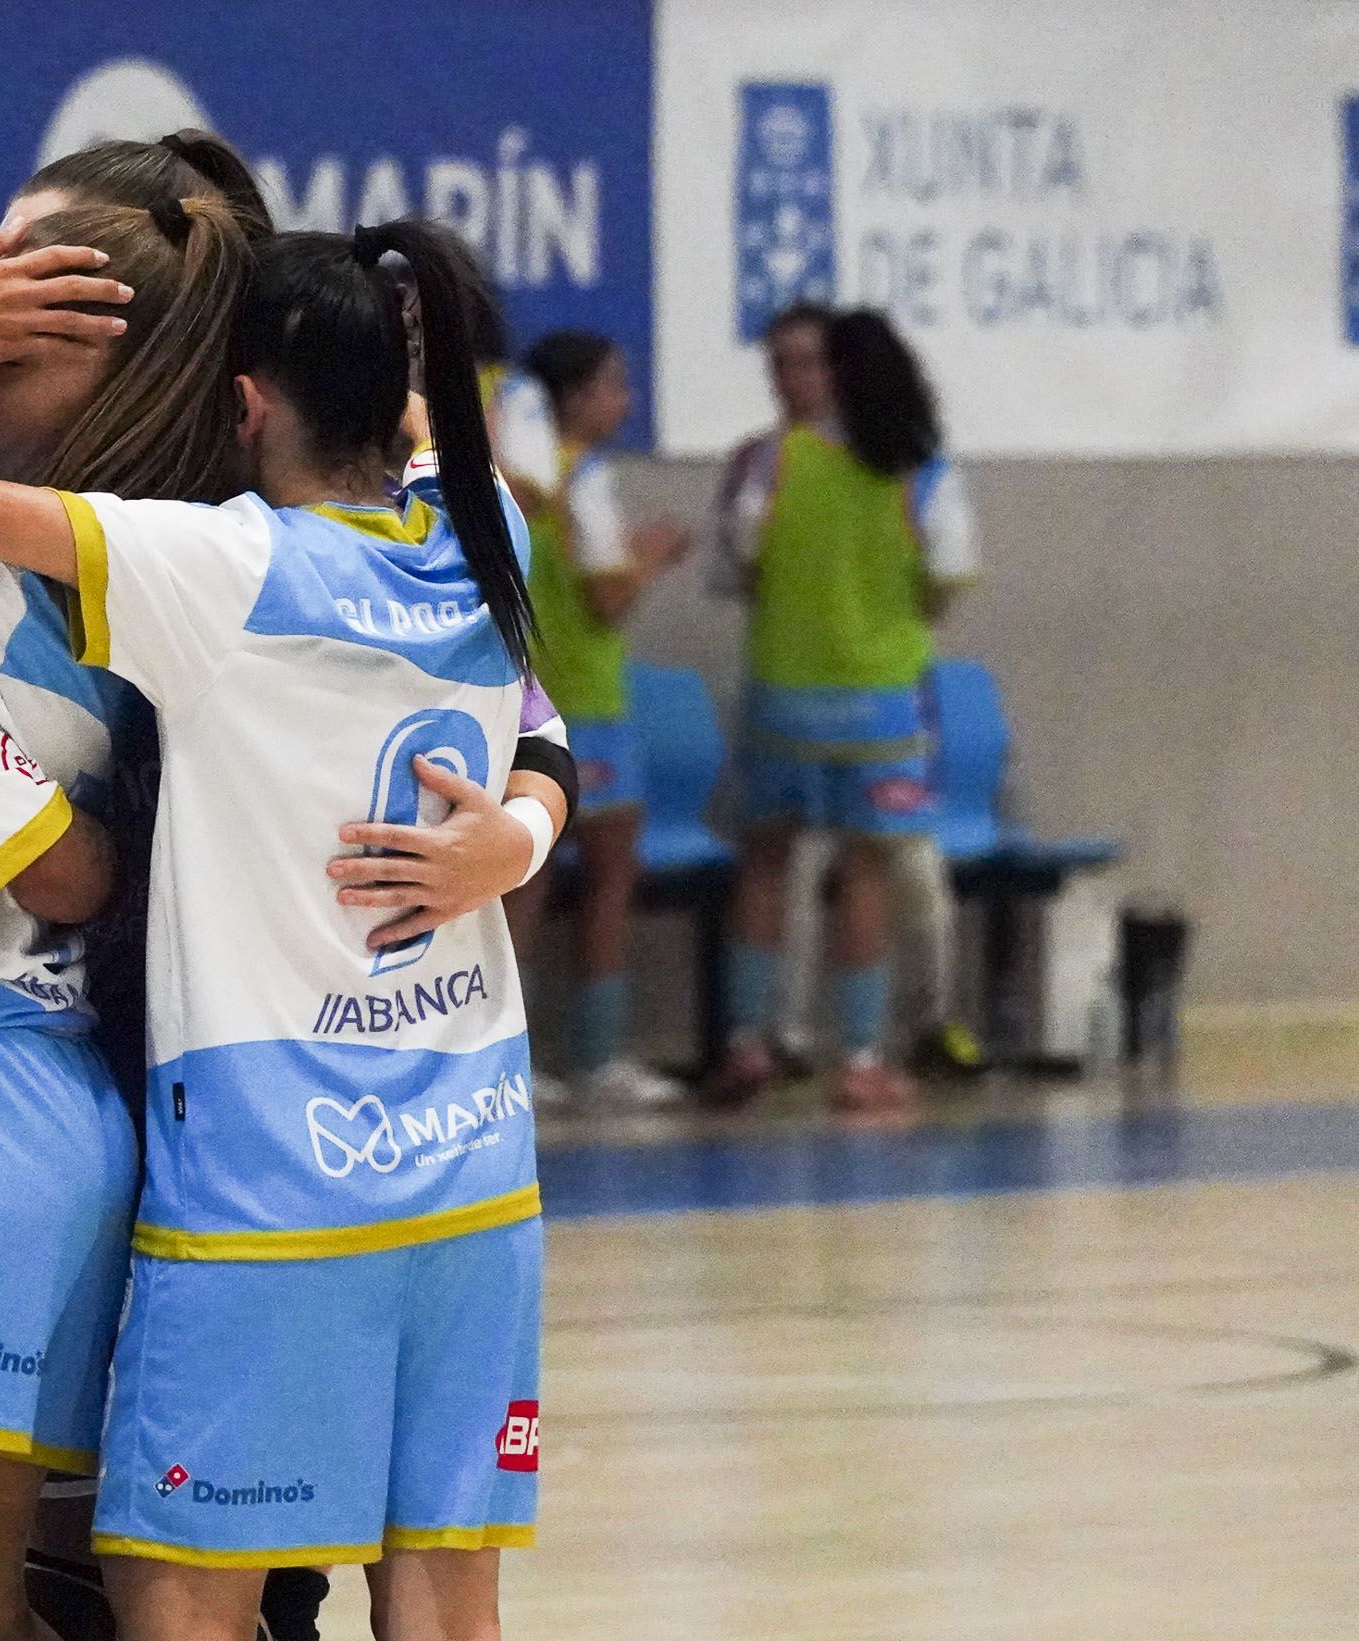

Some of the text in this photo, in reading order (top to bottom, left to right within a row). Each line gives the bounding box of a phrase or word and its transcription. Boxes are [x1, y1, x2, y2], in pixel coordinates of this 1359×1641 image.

[860, 105, 1087, 201] XUNTA
[399, 1071, 530, 1147] MARÍN
[192, 1478, 316, 1506] Domino's
